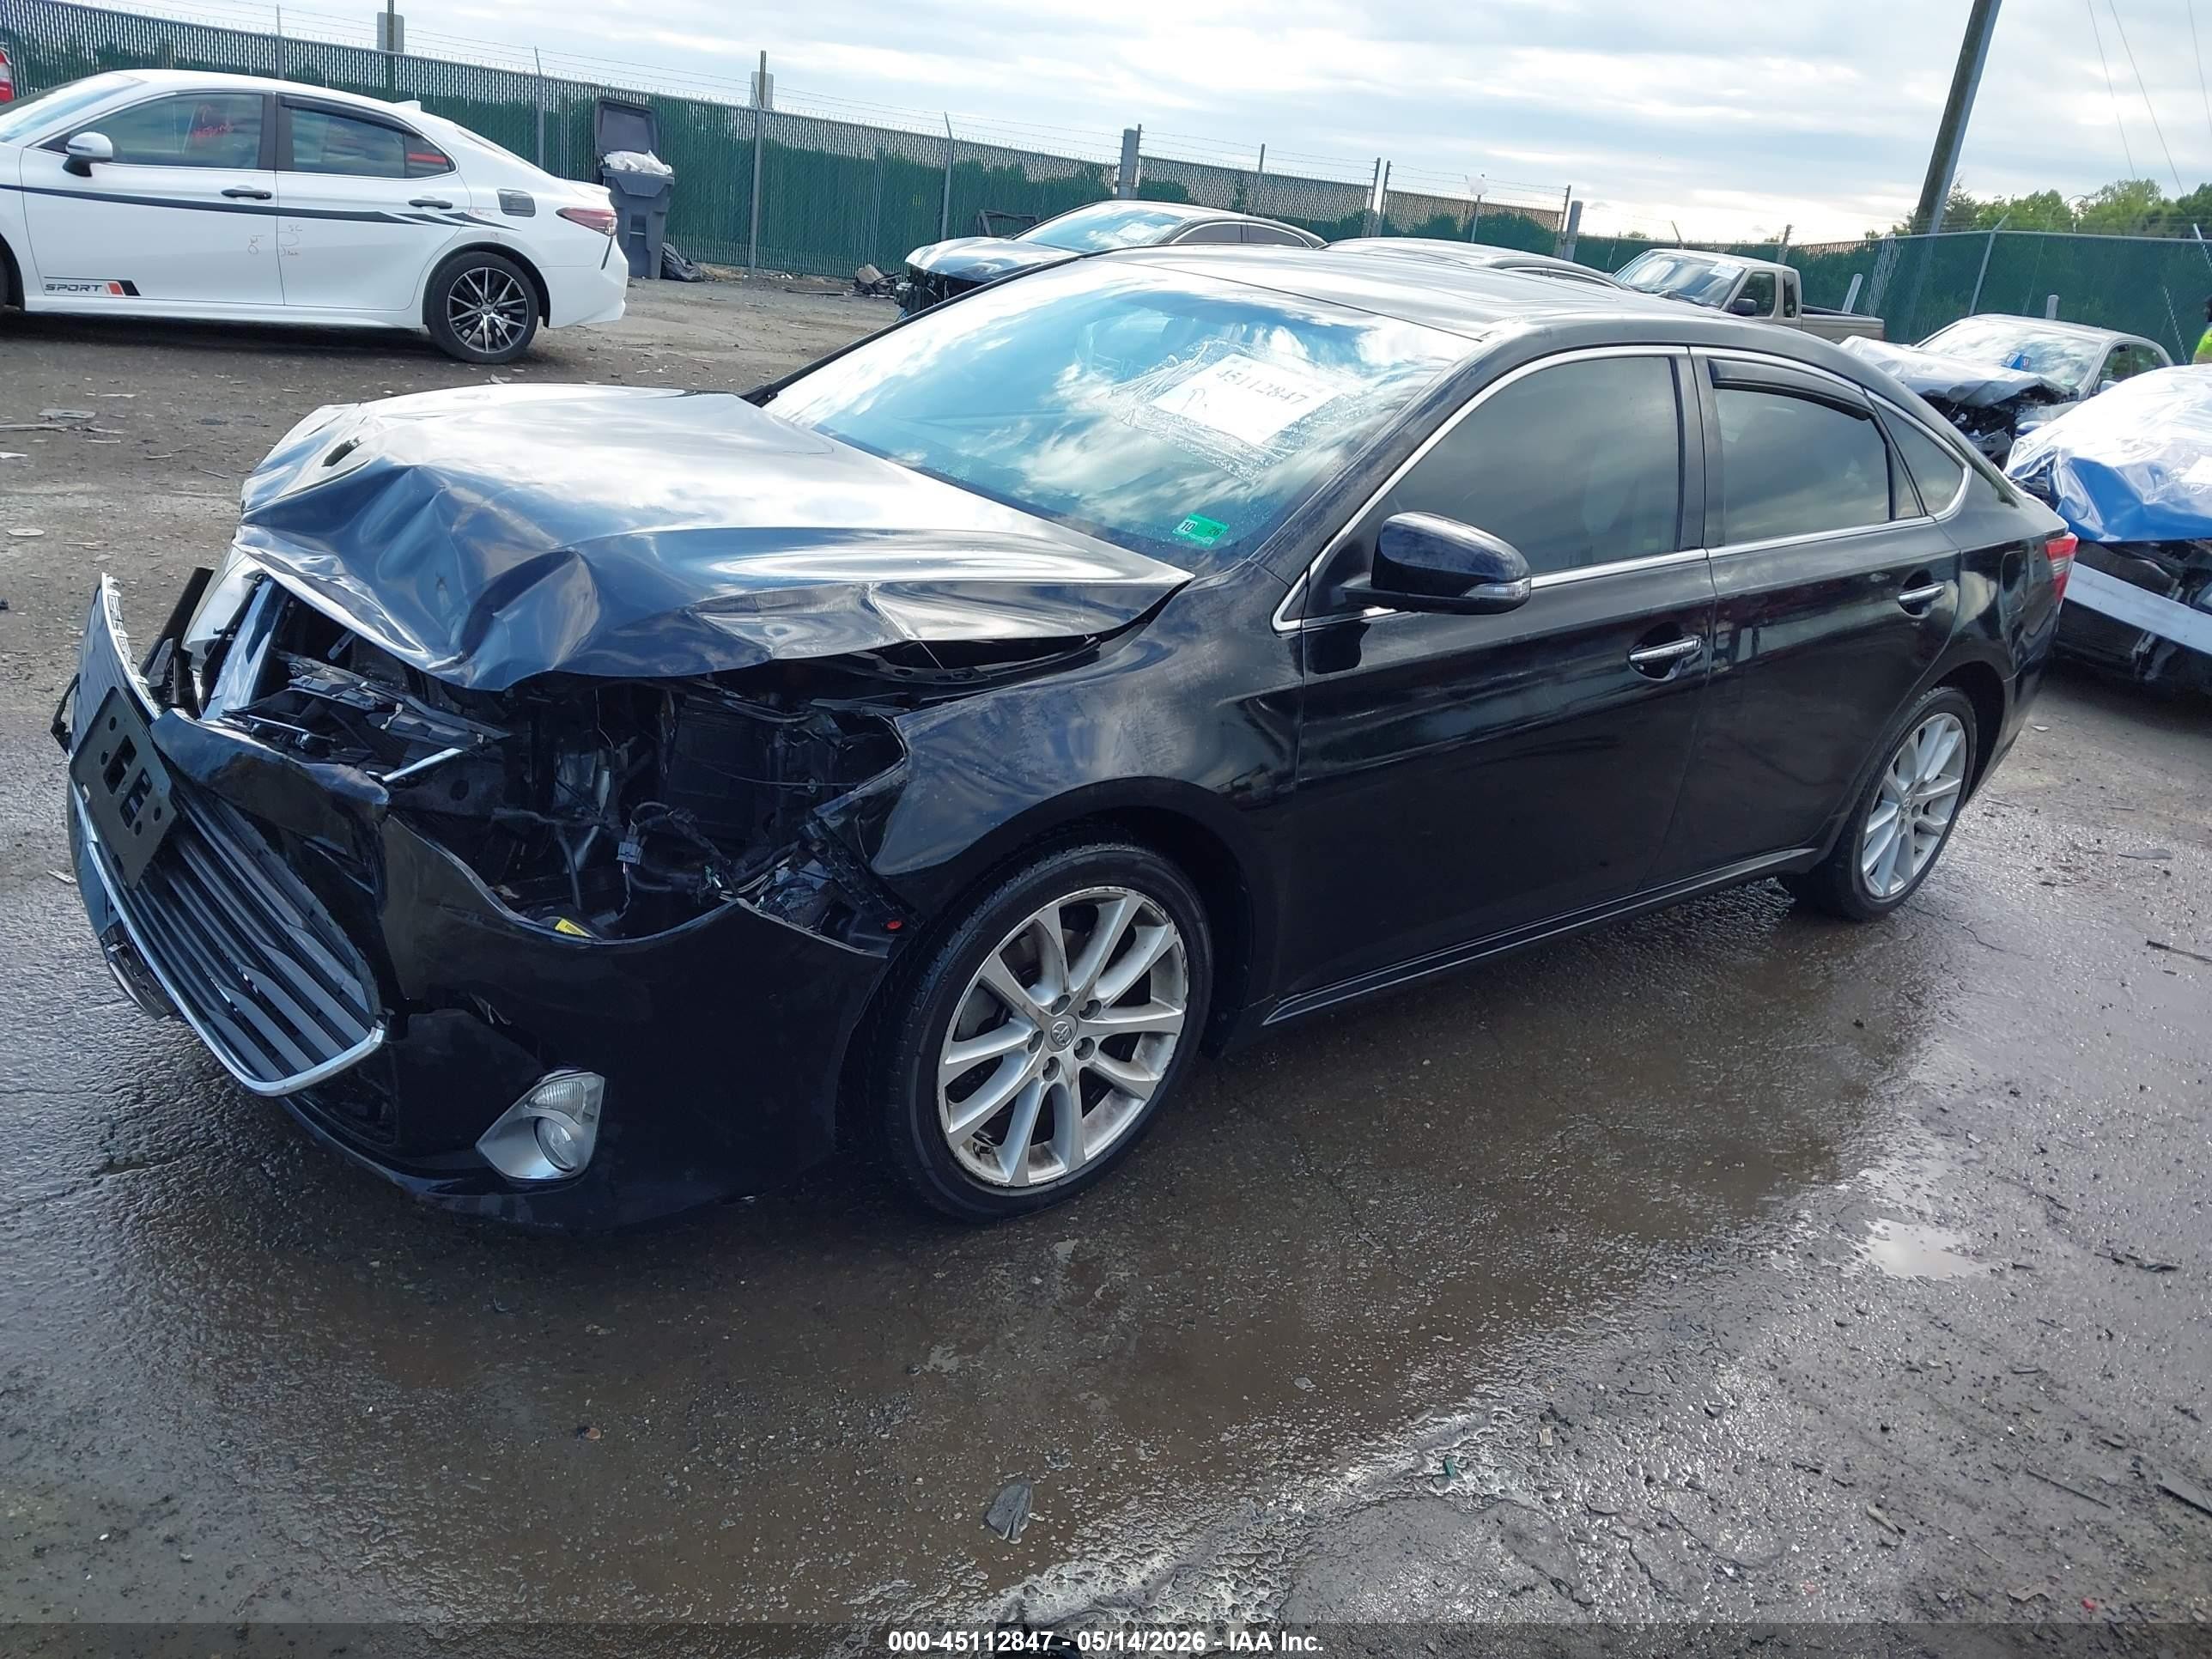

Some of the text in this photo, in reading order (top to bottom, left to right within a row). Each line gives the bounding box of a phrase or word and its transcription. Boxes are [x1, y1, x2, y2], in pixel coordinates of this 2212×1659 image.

[45, 283, 103, 292] SPORT
[1215, 368, 1310, 406] 45112847
[1181, 521, 1196, 532] 10
